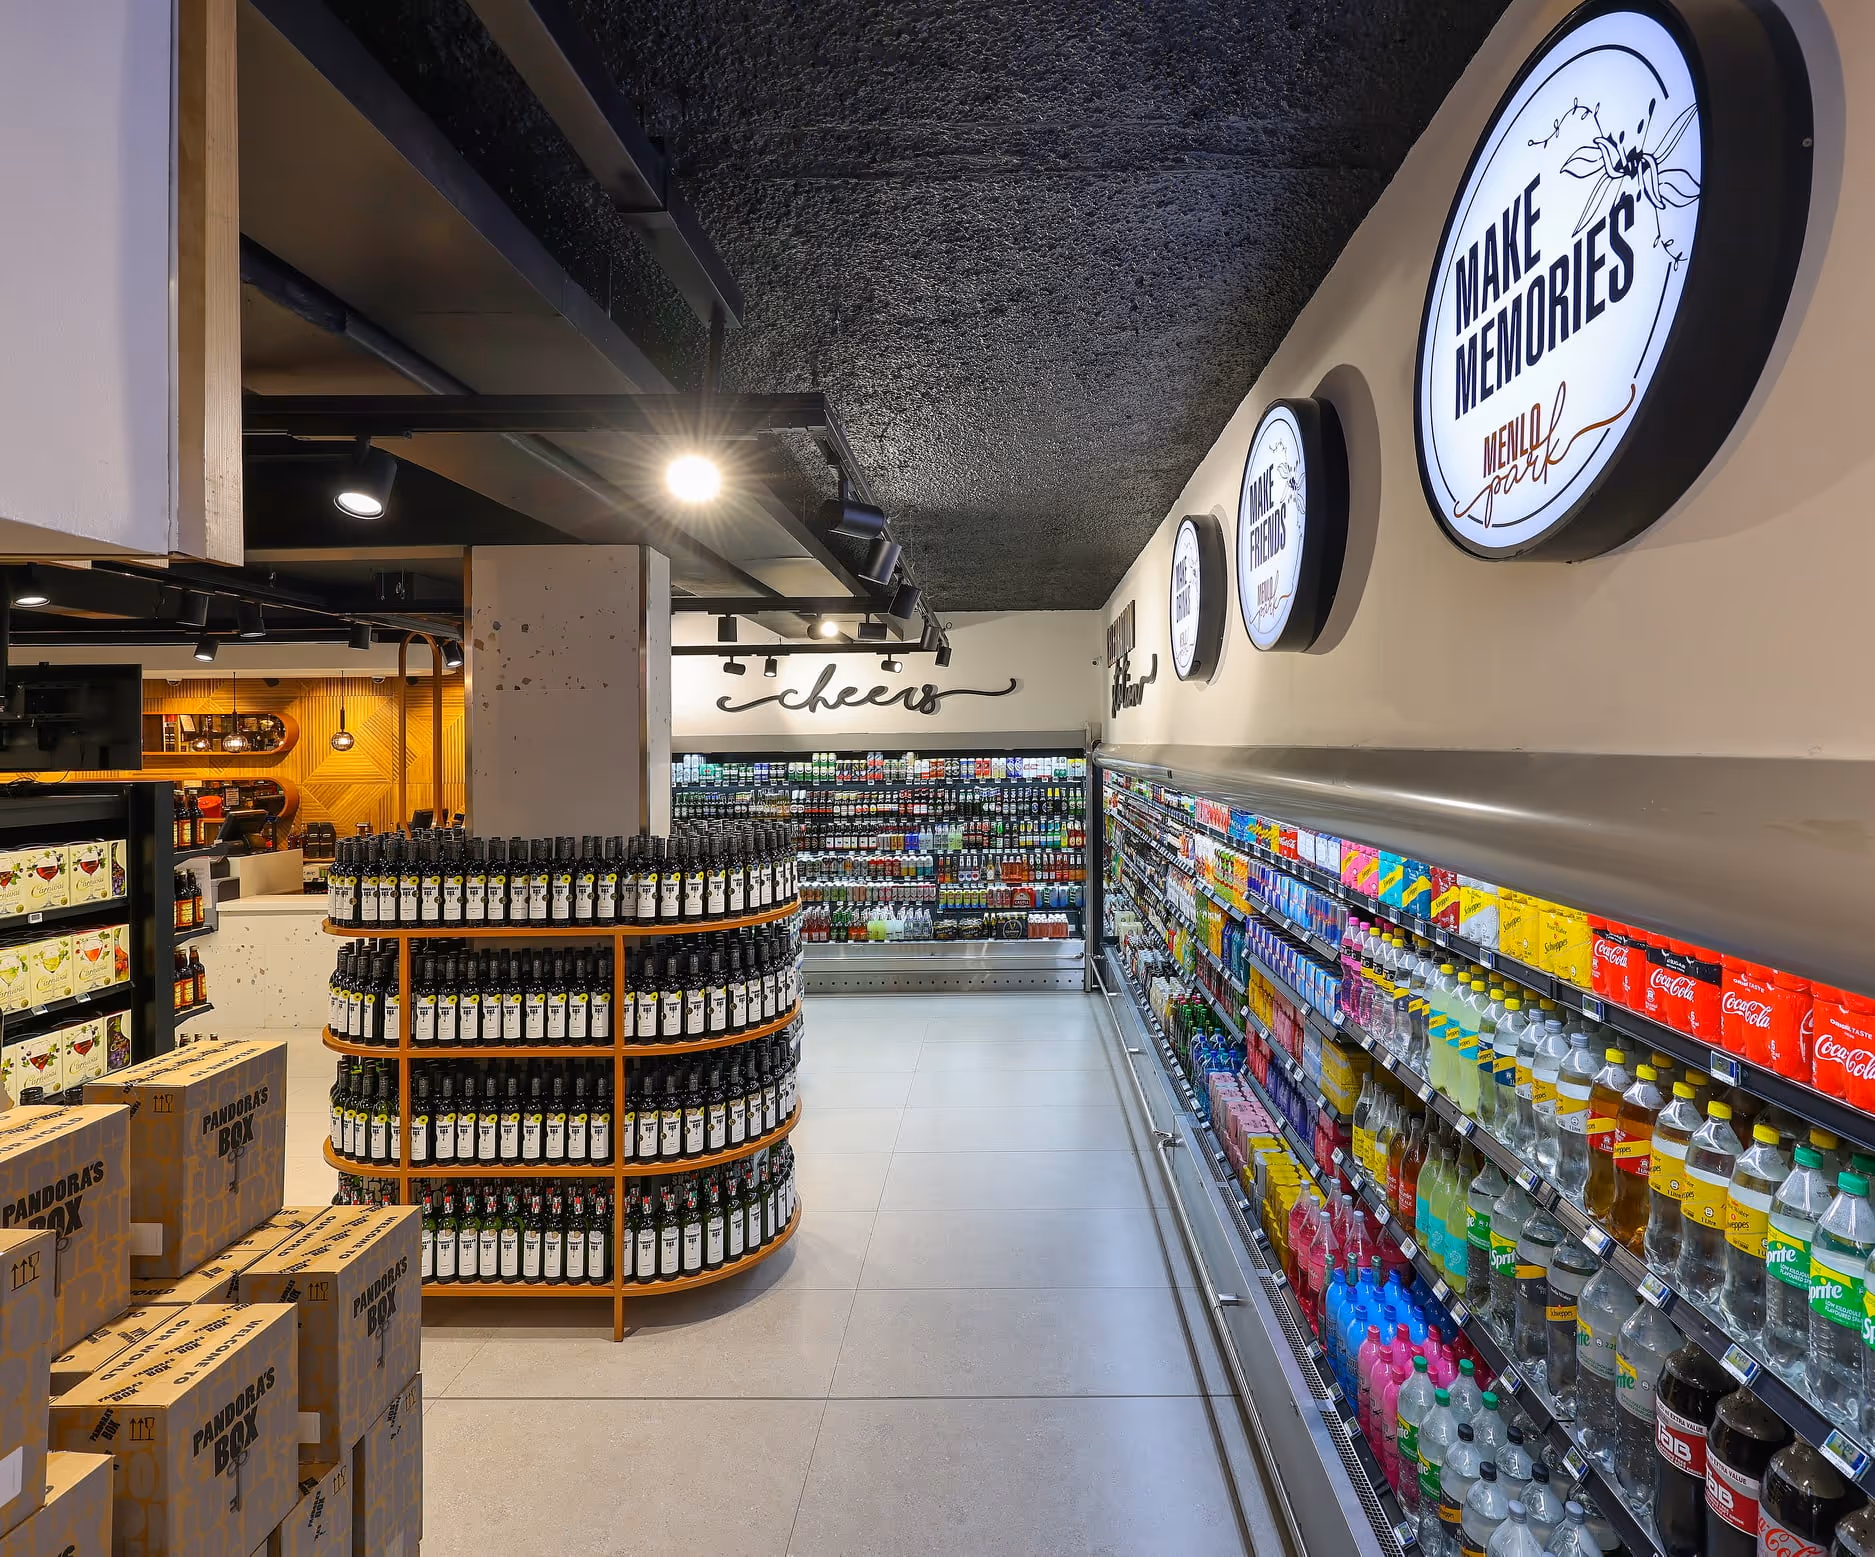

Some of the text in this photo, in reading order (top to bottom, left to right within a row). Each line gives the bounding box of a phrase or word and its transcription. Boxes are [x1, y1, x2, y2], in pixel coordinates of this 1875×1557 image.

[1455, 175, 1541, 336] MAKE
[1455, 198, 1635, 420] MEMORIES
[1482, 403, 1541, 478] MENLO
[1249, 463, 1275, 526] MAKE
[1249, 502, 1287, 572] FRIENDS
[716, 664, 1016, 715] cheers
[31, 881, 65, 898] Carnival
[1503, 915, 1522, 932] Schweppes
[1544, 939, 1568, 955] Schweppes
[1594, 939, 1629, 968] Coca-Cola
[36, 971, 68, 991] Carnival
[1650, 968, 1696, 1001] Coca-Cola
[1722, 992, 1773, 1029] Coca-Cola
[202, 1086, 268, 1135] PANDORA'S
[218, 1112, 255, 1158] BOX
[2, 1160, 104, 1229] PANDORA'S
[1704, 1218, 1717, 1226] Litre
[1491, 1249, 1516, 1269] Sprit
[353, 1256, 408, 1319] PANDORA'S
[367, 1285, 398, 1337] BOX
[100, 1319, 190, 1381] OUR WORLD
[173, 1319, 263, 1385] WELCOME TO
[177, 1341, 203, 1355] BOX
[146, 1364, 172, 1377] BOX
[111, 1387, 140, 1402] BOX
[193, 1367, 276, 1458] PANDORA'S
[101, 1420, 120, 1440] BOX
[214, 1403, 260, 1477] BOX
[1670, 1411, 1704, 1434] EXTRA VALUE
[1727, 1469, 1748, 1486] VALUE
